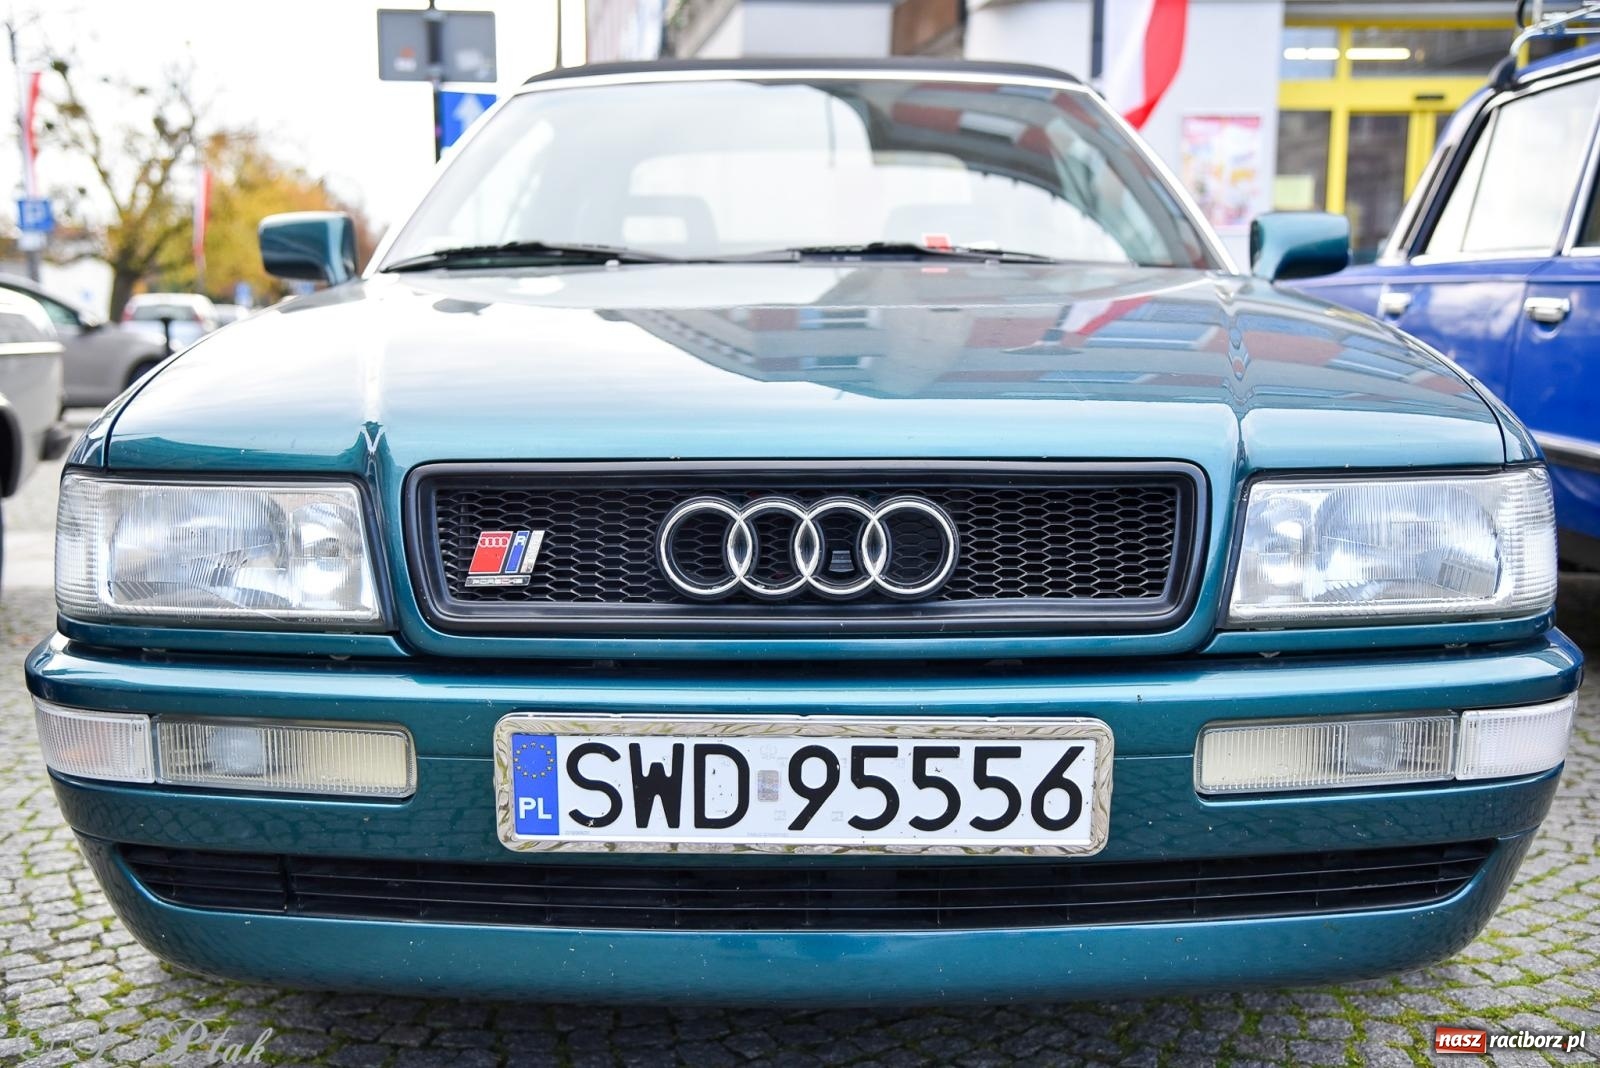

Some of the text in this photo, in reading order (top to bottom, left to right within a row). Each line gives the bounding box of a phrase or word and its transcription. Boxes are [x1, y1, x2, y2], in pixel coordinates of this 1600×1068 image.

[518, 797, 553, 820] PL
[566, 742, 1085, 832] SWD 95556
